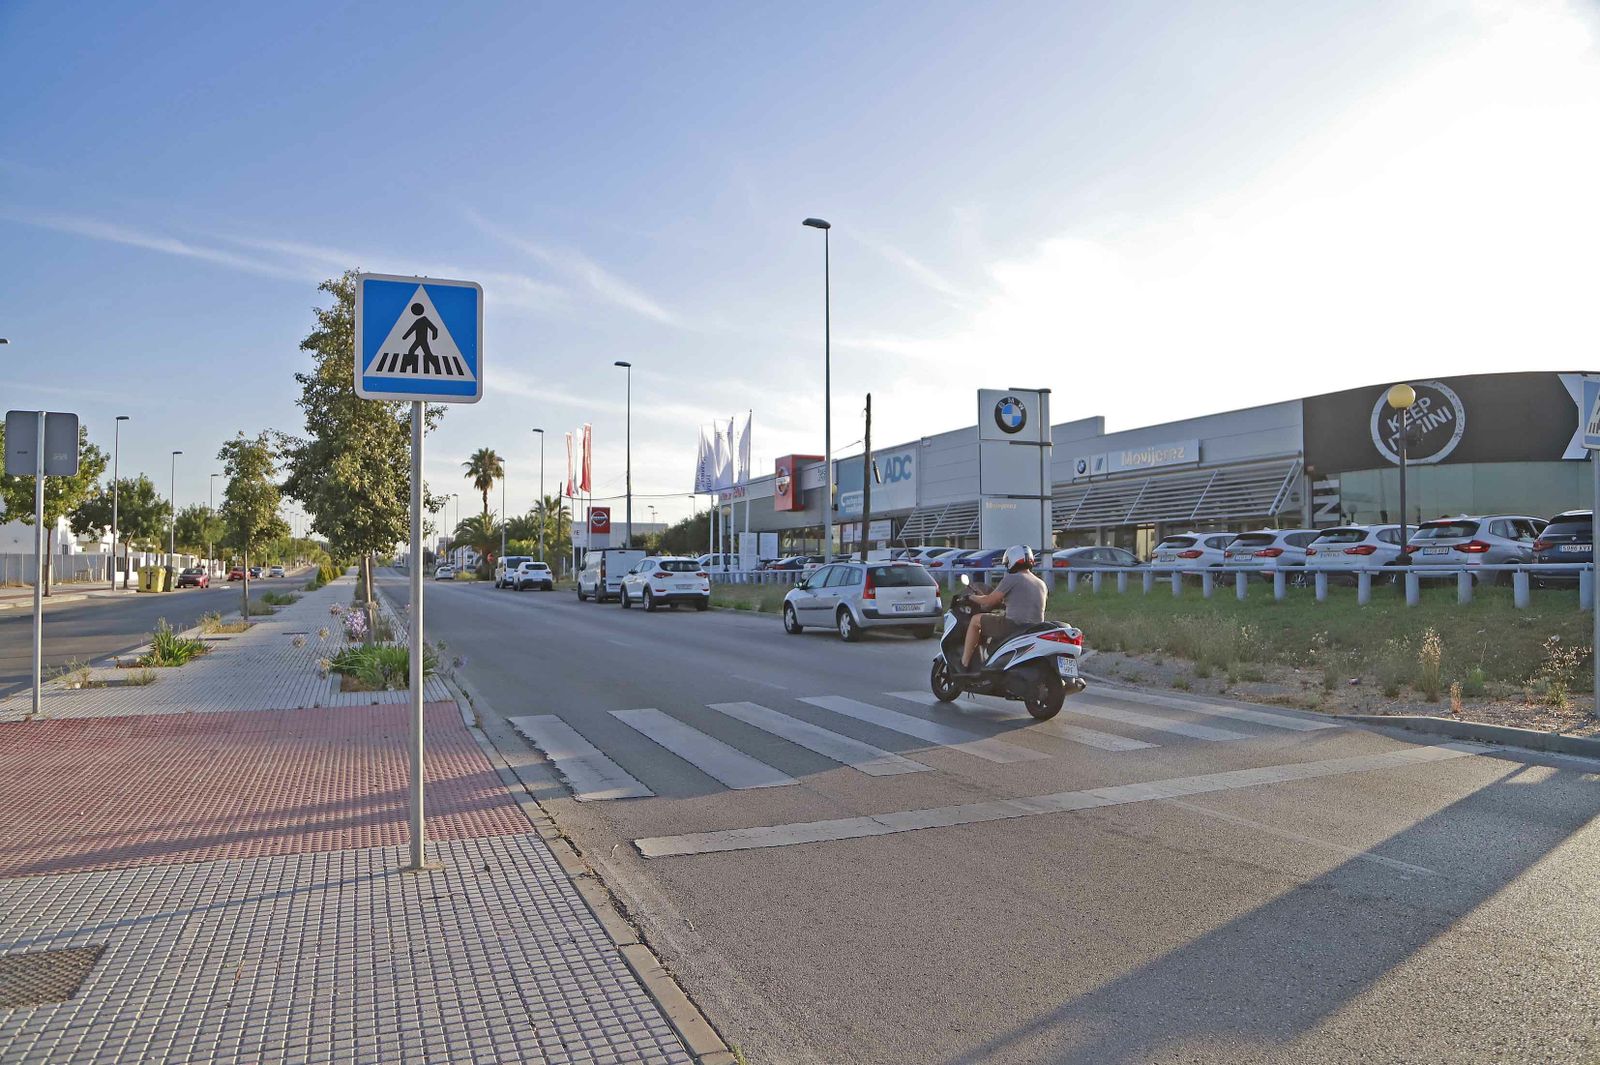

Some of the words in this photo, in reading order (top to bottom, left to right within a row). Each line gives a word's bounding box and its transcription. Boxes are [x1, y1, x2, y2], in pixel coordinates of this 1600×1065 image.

[998, 397, 1025, 410] BMW
[1121, 446, 1185, 467] Movijerez
[884, 454, 912, 485] ADC
